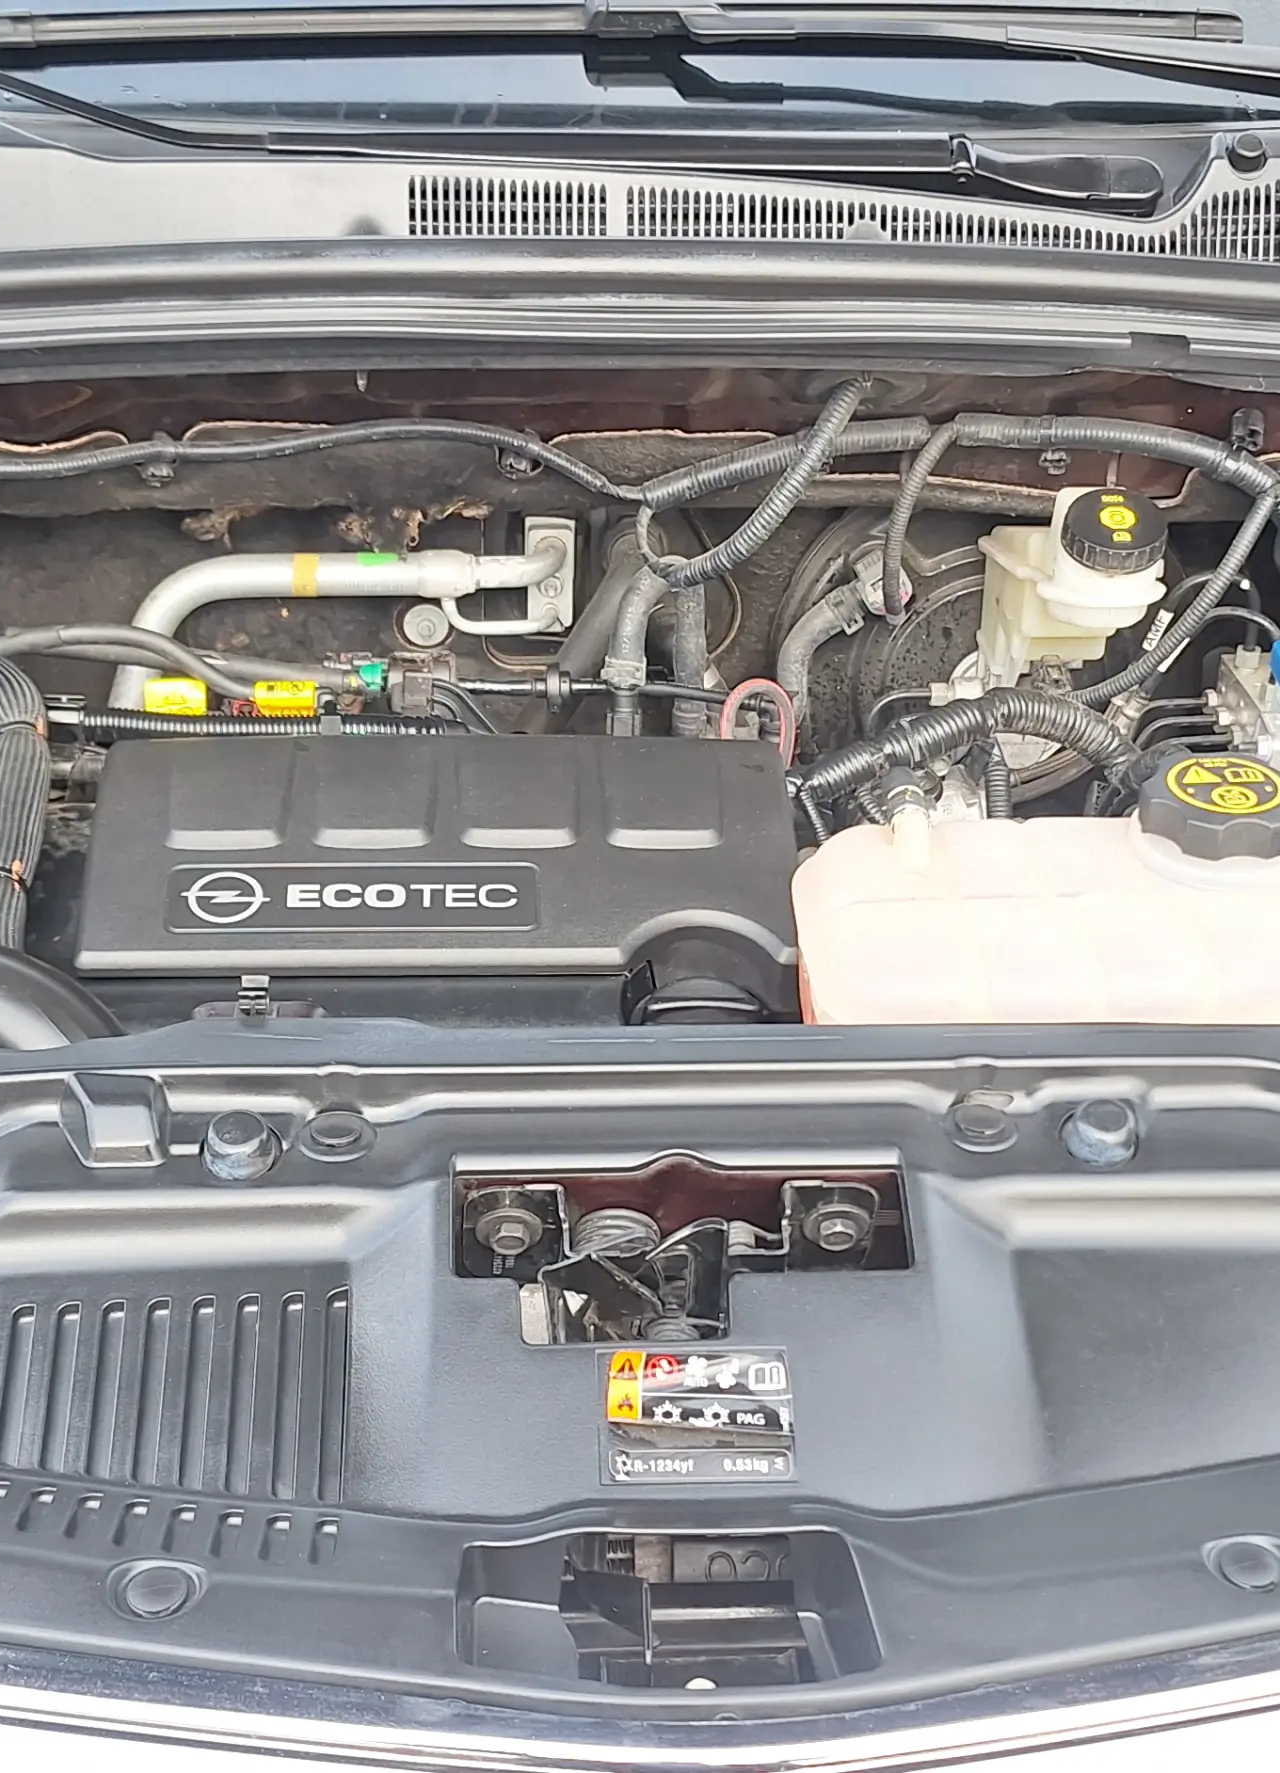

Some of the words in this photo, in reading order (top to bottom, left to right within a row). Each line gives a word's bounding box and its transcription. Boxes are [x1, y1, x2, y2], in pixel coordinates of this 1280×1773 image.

[1144, 615, 1166, 647] AMF
[286, 883, 518, 908] ECOTEC
[736, 1412, 766, 1426] PAG
